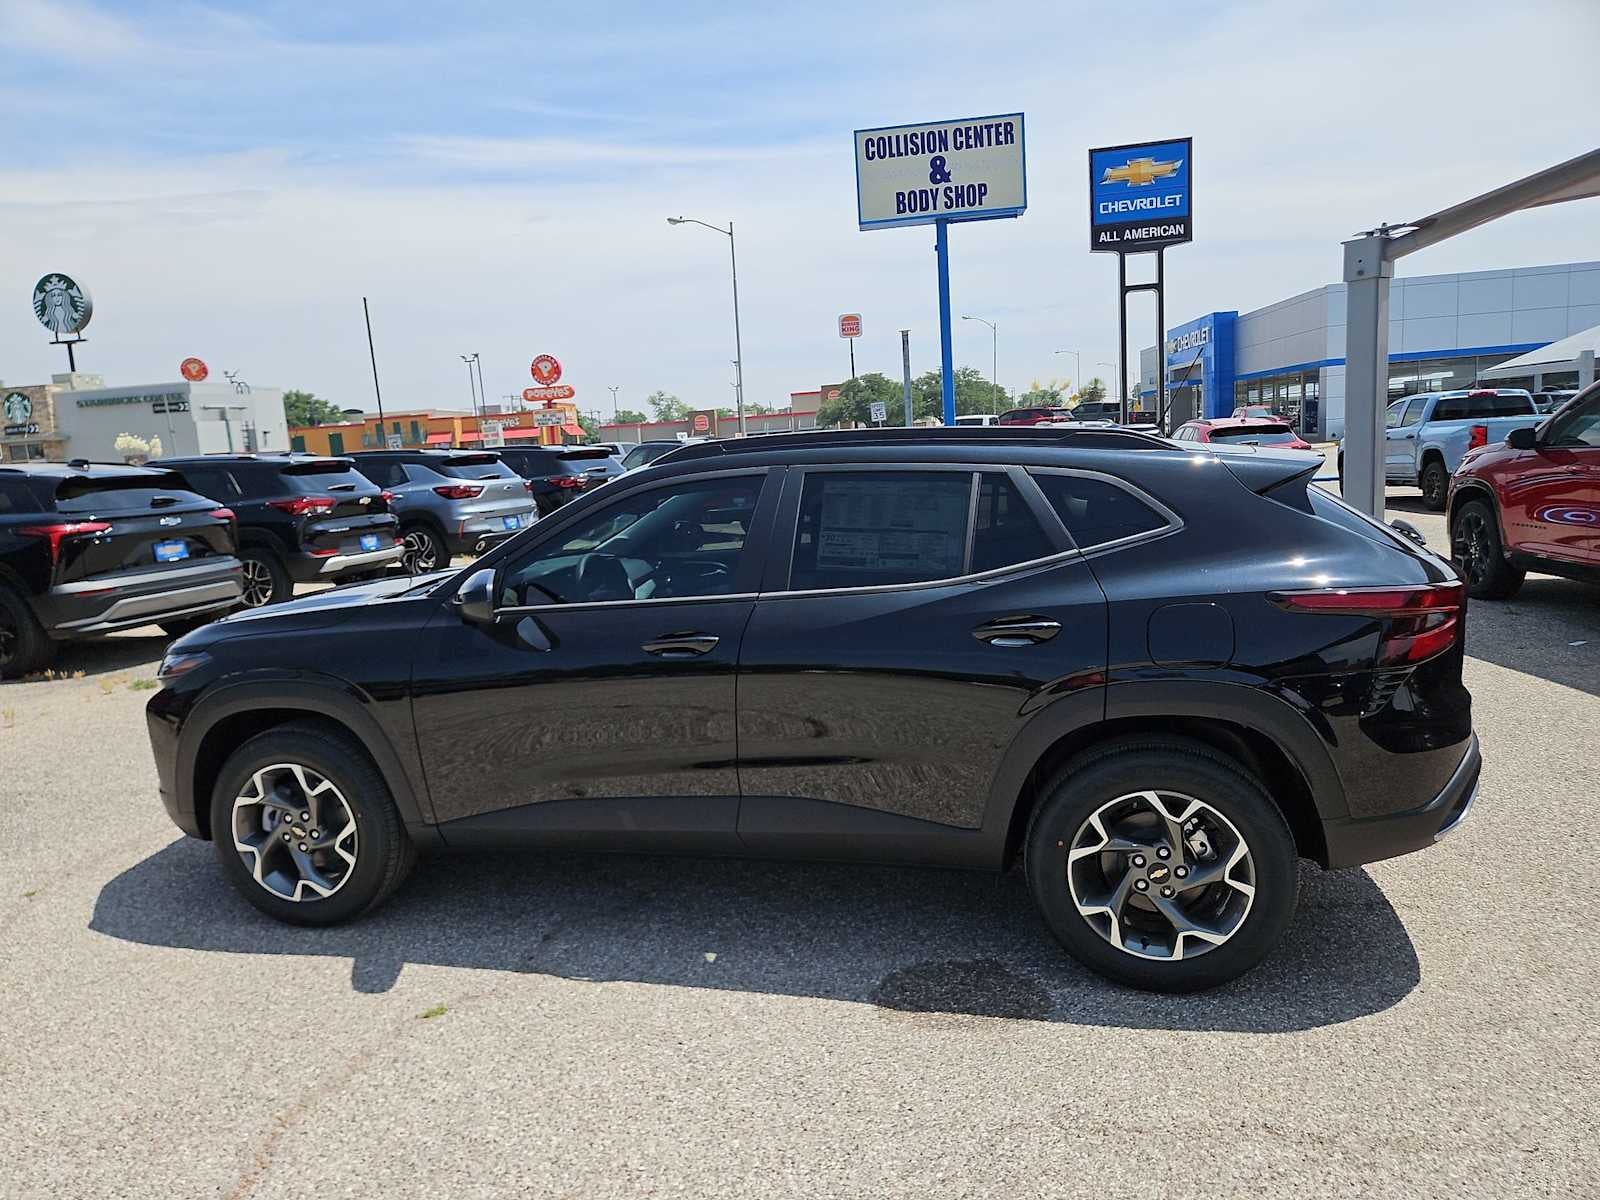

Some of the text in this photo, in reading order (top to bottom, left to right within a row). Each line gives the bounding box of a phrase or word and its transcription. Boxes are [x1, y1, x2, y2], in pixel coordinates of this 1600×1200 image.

[864, 121, 1015, 160] COLLISION CENTER
[929, 155, 952, 184] &
[896, 183, 988, 215] BODY SHOP
[1099, 194, 1183, 215] CHEVROLET
[1099, 223, 1185, 243] ALL AMERICAN
[841, 325, 860, 333] KING
[1177, 327, 1209, 351] CHEVROLET
[873, 412, 885, 420] 35
